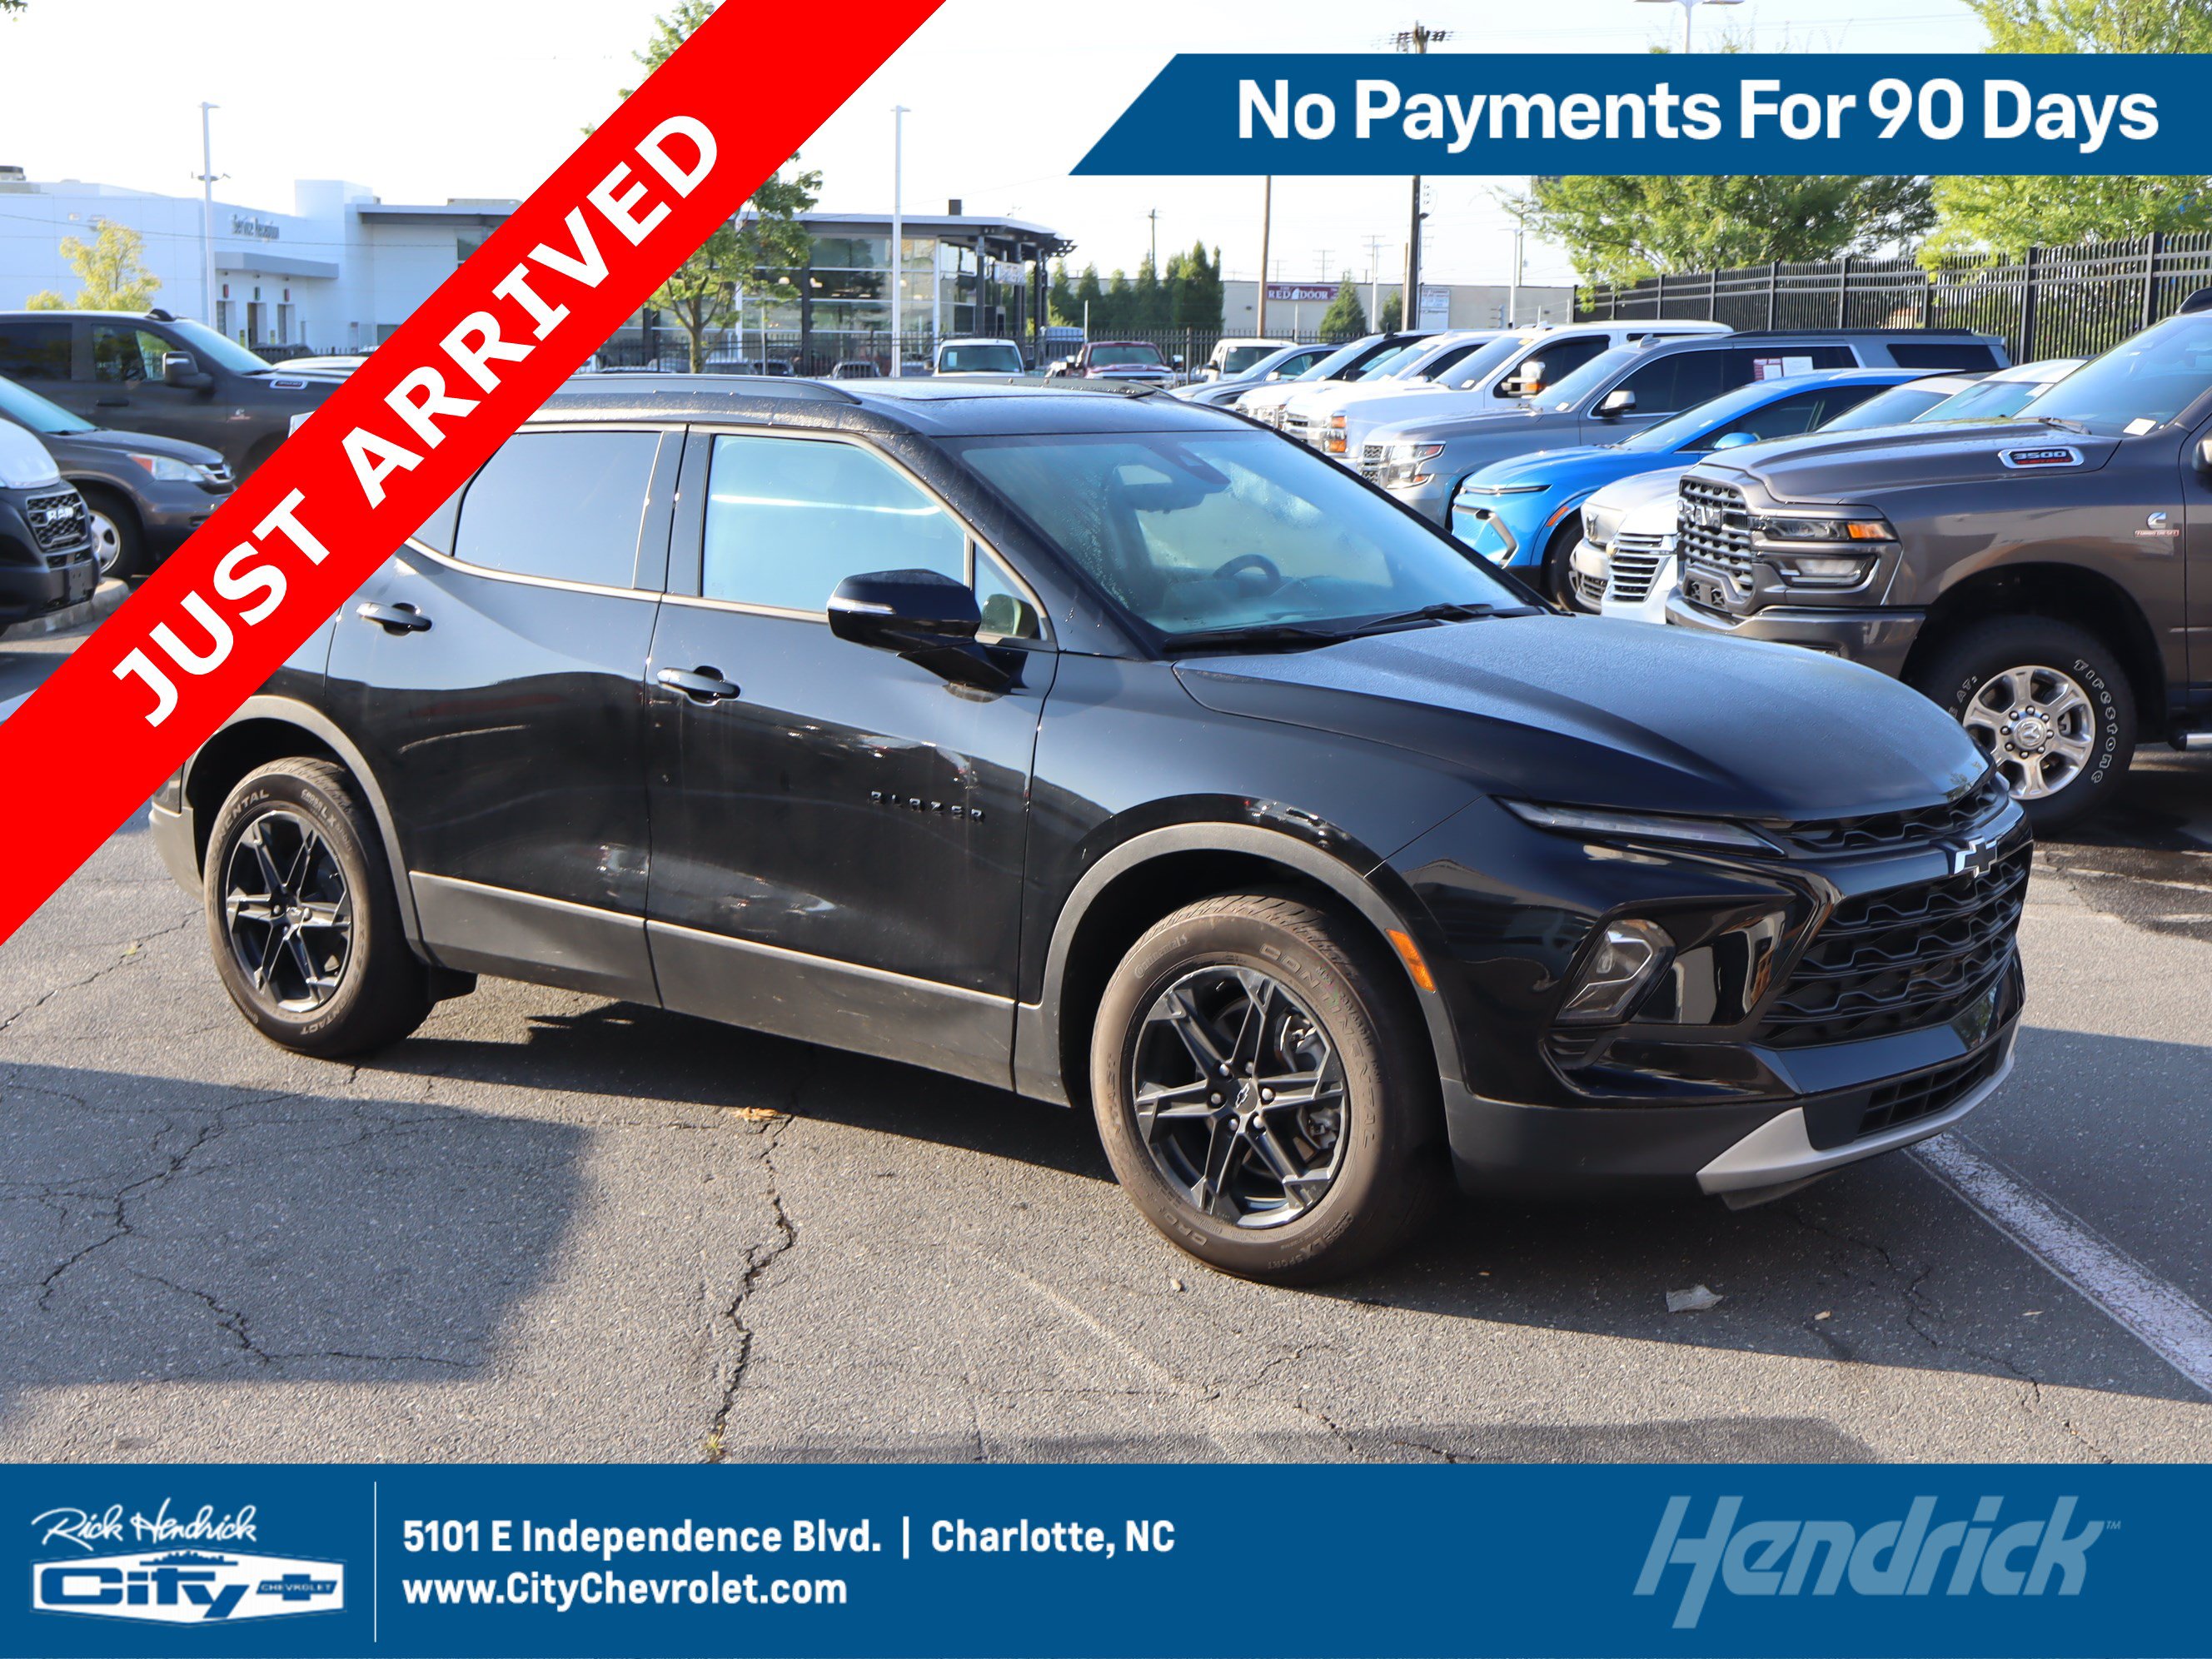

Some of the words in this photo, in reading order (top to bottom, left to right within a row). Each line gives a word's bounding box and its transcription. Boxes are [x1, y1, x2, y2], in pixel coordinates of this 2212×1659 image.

[1268, 290, 1291, 300] RED
[1300, 290, 1328, 300] DOOR
[2013, 451, 2067, 461] 3500
[870, 791, 983, 824] BLAZER
